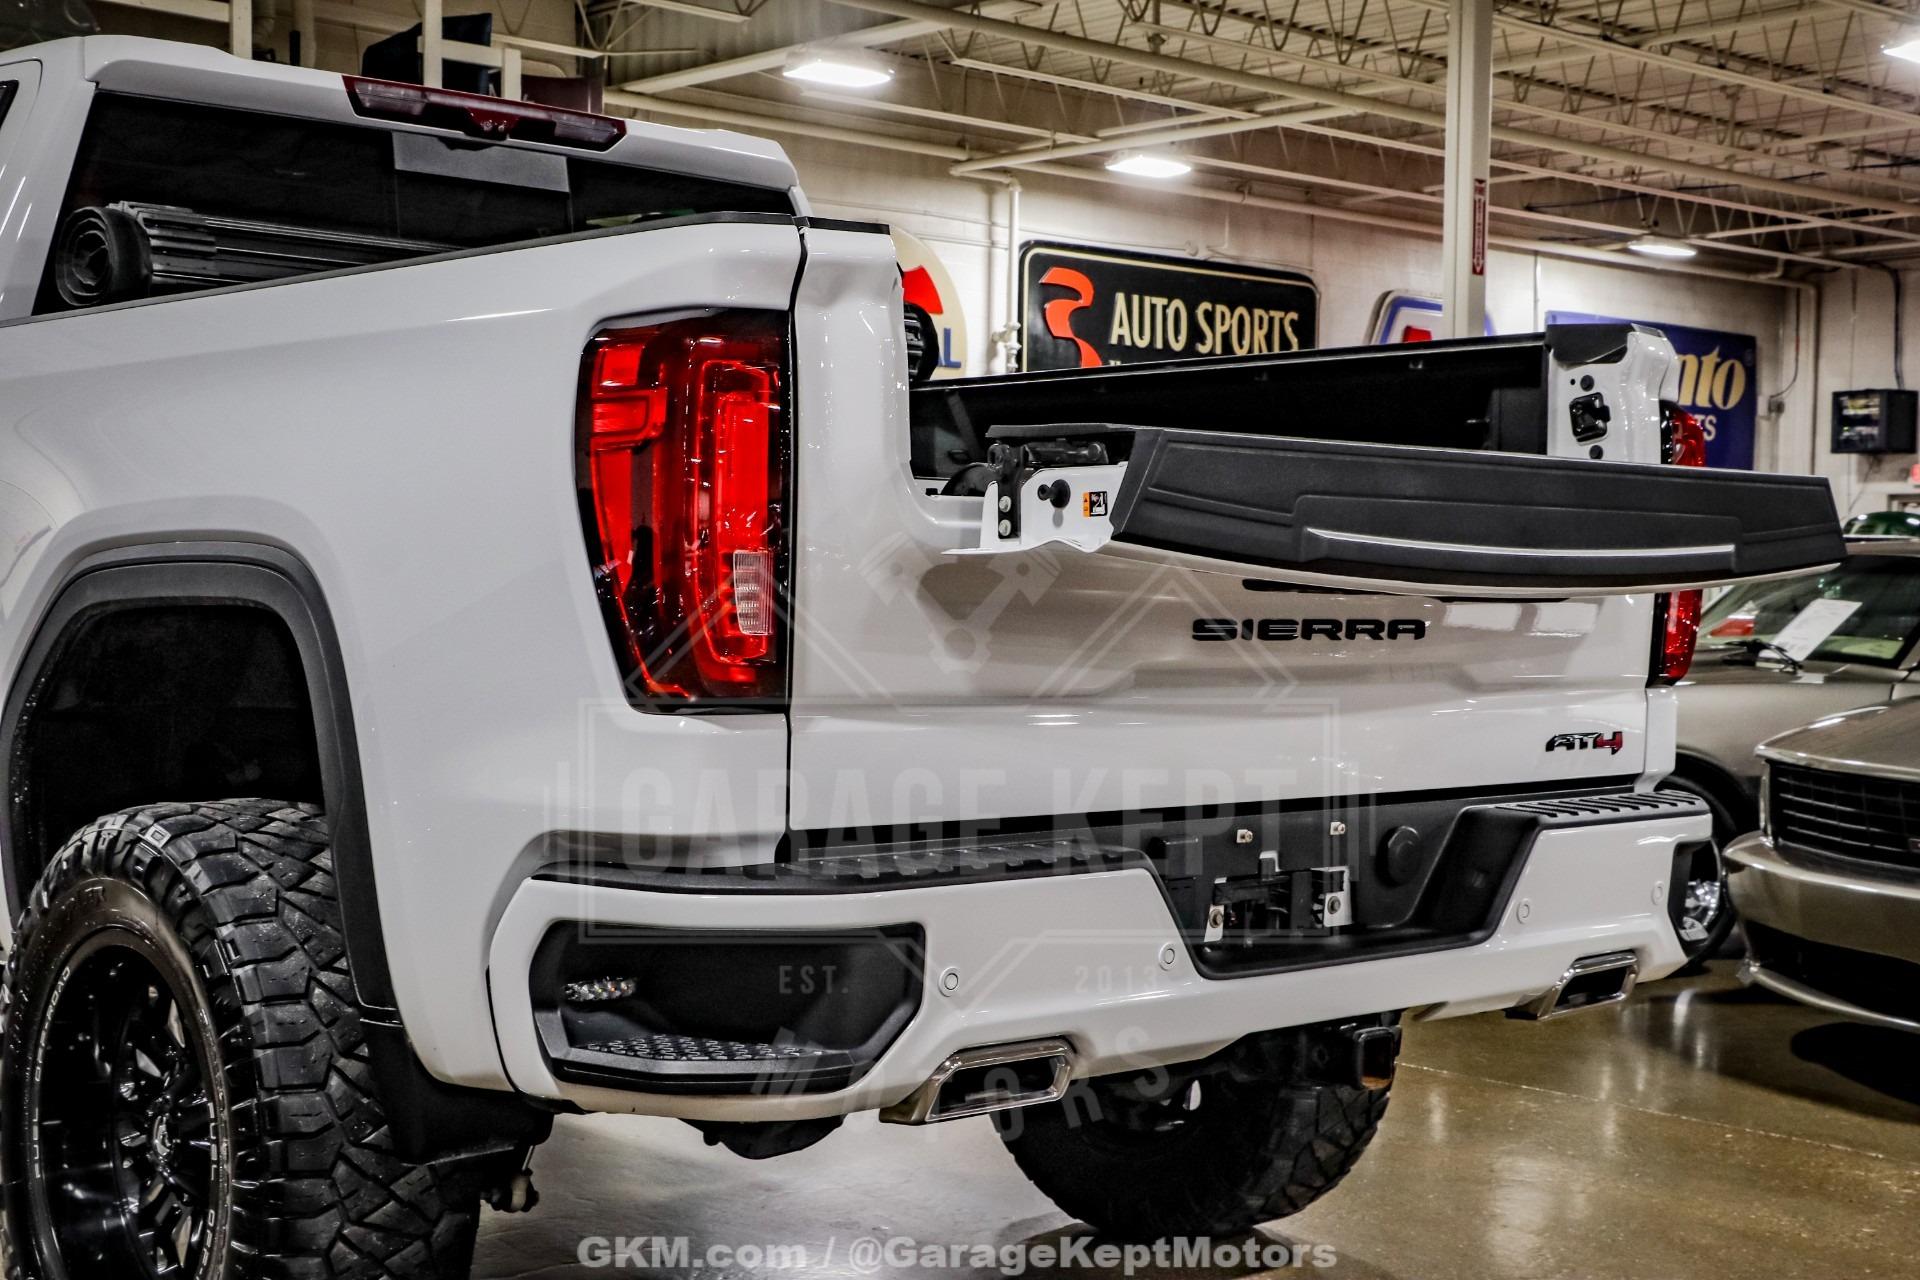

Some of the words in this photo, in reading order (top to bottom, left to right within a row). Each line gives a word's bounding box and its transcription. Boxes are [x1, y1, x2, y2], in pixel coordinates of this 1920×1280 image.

[1110, 292, 1188, 353] AUTO
[1195, 301, 1300, 356] SPORTS
[1191, 618, 1426, 642] SIERRA
[1544, 730, 1624, 756] AT4
